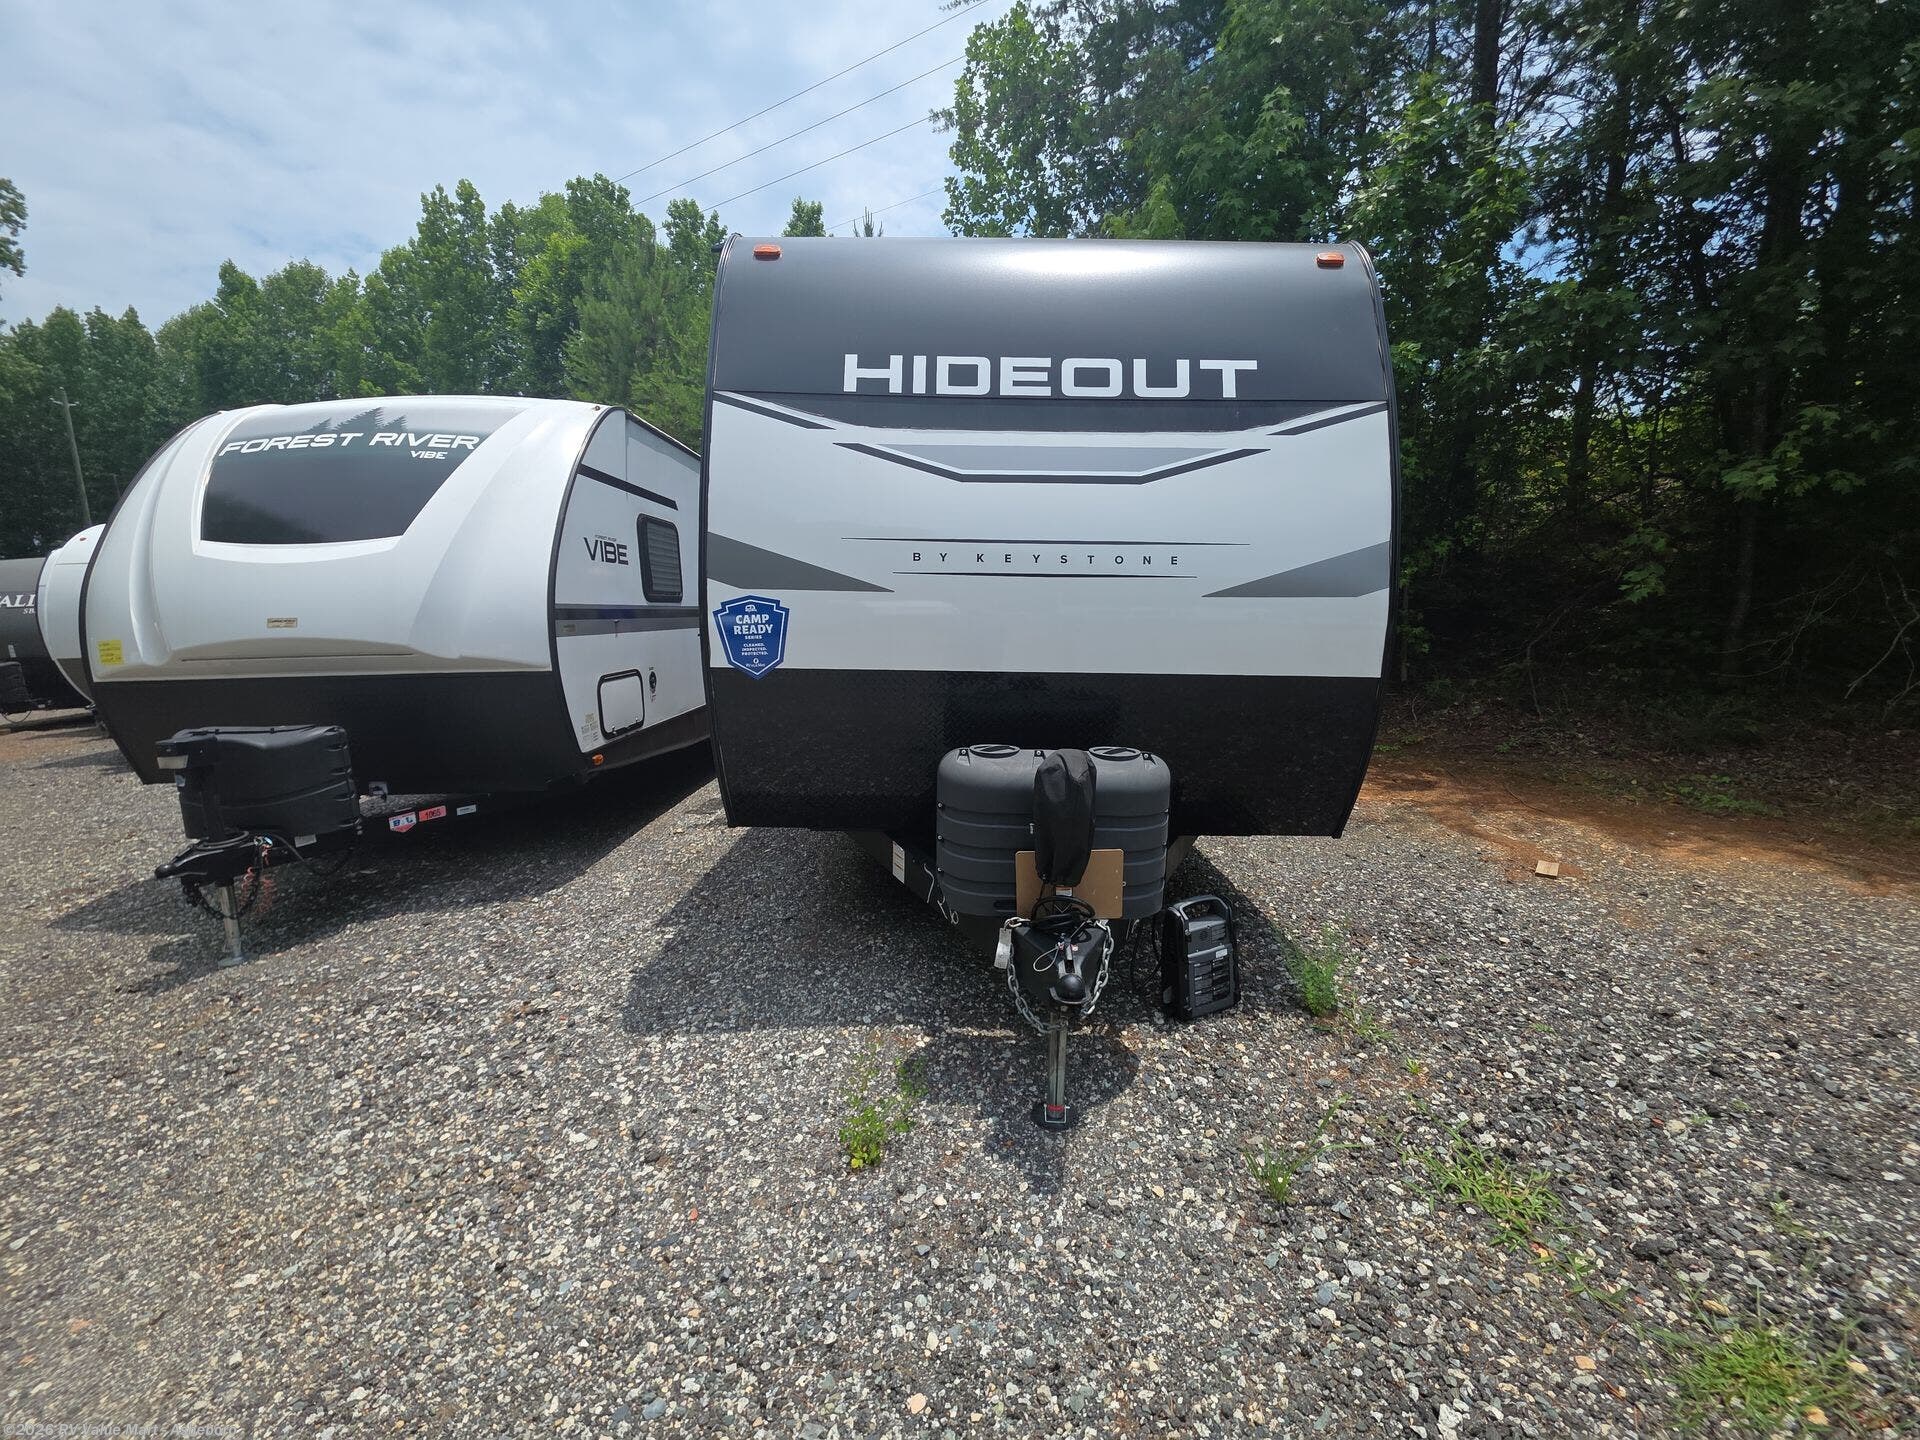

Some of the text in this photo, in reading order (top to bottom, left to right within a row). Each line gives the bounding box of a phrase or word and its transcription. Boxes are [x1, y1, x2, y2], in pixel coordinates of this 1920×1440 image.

[843, 354, 1258, 398] HIDEOUT
[218, 432, 480, 457] FOREST RIVER
[410, 450, 448, 460] VIBE
[583, 537, 629, 566] VIBE
[912, 552, 1178, 565] BY KEYSTONE
[0, 594, 36, 608] ALI
[735, 613, 770, 624] CAMP
[733, 624, 773, 635] READY
